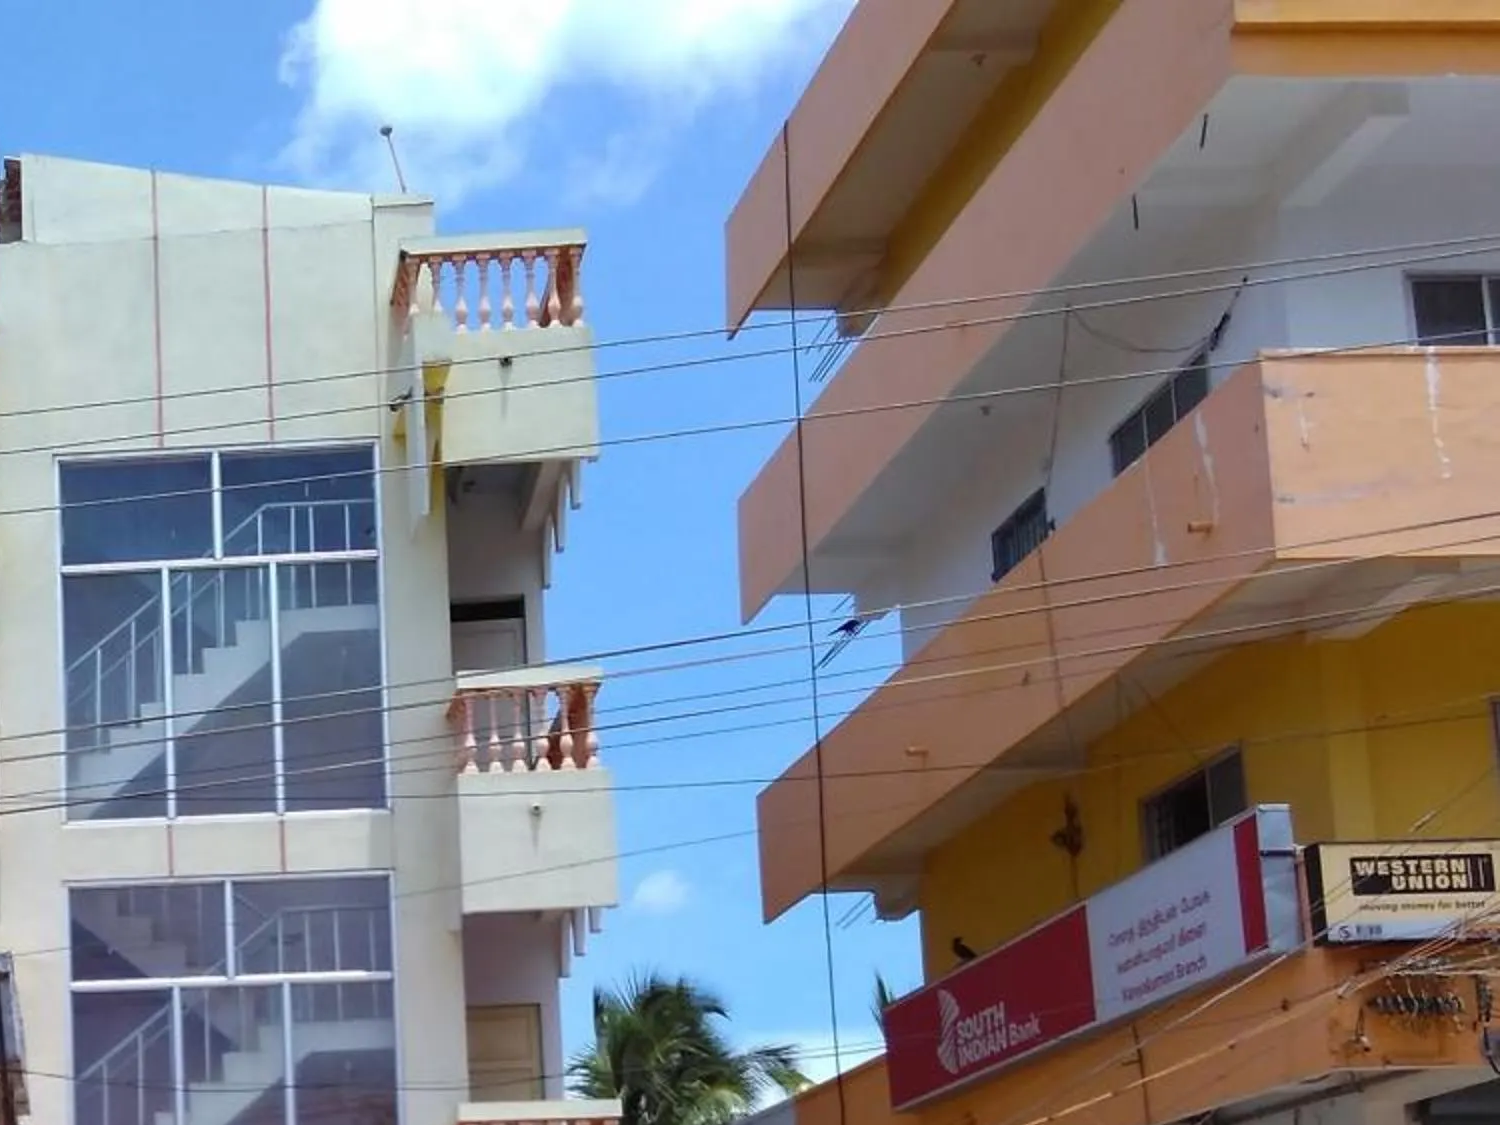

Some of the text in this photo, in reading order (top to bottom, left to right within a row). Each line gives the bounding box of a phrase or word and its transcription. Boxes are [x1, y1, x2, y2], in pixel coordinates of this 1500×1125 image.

[1353, 858, 1467, 876] WESTERN
[1391, 874, 1468, 891] UNION
[957, 1000, 1005, 1039] SOUTH
[957, 1012, 1041, 1068] INDIAN Bank
